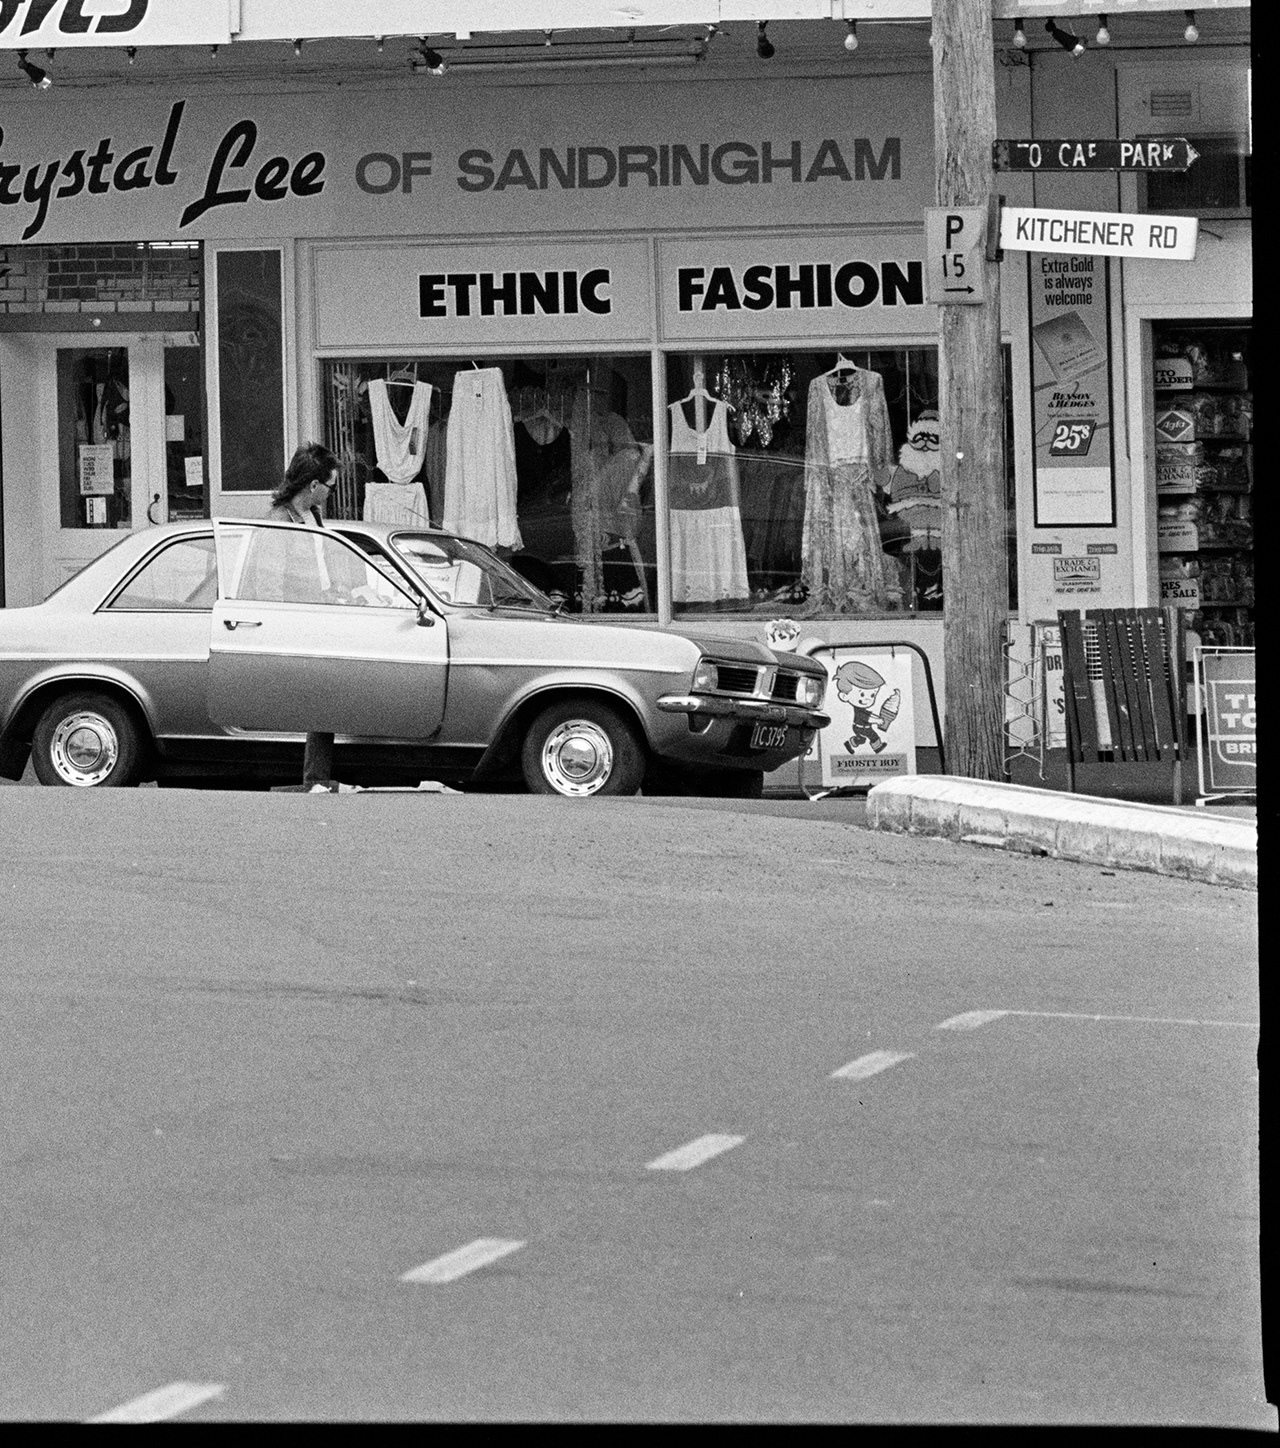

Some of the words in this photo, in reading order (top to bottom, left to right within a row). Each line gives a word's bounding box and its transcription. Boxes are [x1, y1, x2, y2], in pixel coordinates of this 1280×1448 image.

[179, 119, 326, 229] Lee
[355, 152, 432, 194] OF
[456, 137, 902, 193] SANDRINGHAM
[945, 214, 965, 250] P
[1016, 217, 1134, 246] KITCHENER
[1149, 226, 1178, 249] RD
[942, 253, 966, 278] 15
[1041, 257, 1069, 273] Extra
[1070, 257, 1094, 272] Gold
[418, 269, 612, 318] ETHNIC
[677, 261, 924, 312] FASHION
[1044, 274, 1054, 290] is
[1055, 273, 1093, 291] always
[1044, 290, 1093, 306] welcome
[1155, 369, 1176, 377] TO
[1052, 392, 1090, 401] BENSON
[1054, 400, 1096, 408] HEDGES
[1161, 581, 1181, 590] MES
[1173, 589, 1197, 598] SALE
[1226, 743, 1256, 754] BR
[837, 760, 876, 768] FROSTY
[880, 759, 900, 767] BOY
